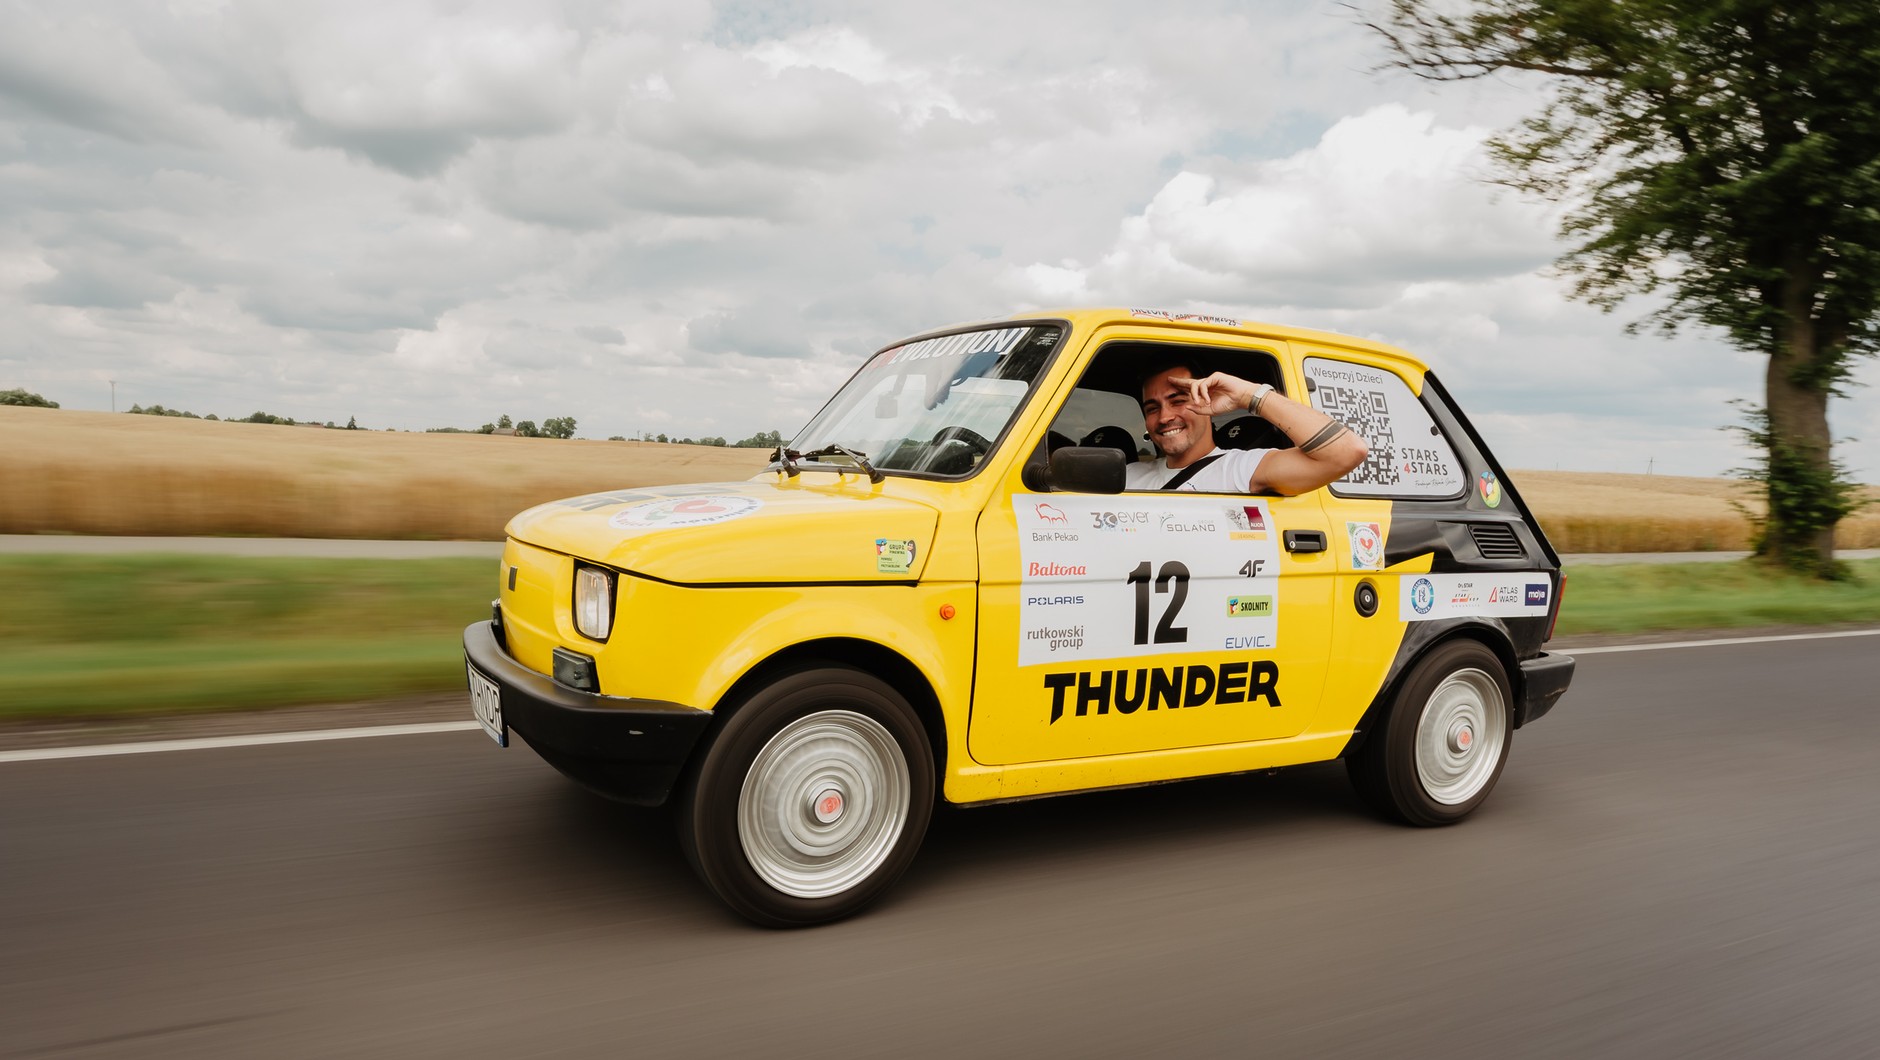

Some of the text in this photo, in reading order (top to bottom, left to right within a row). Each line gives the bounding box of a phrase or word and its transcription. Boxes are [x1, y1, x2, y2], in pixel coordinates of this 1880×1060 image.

[1310, 366, 1383, 384] Wesprzyj Dzieci
[1401, 447, 1439, 462] STARS
[1404, 461, 1448, 476] 4STARS
[1167, 523, 1216, 532] SOLANO
[1032, 532, 1079, 541] Bank Pekao
[1028, 561, 1087, 577] Baltona
[1239, 560, 1265, 578] 4F
[1028, 596, 1084, 606] POLARIS
[1127, 560, 1190, 645] 12
[1241, 602, 1268, 611] SKOLNITY
[1027, 625, 1084, 640] rutkowski
[1050, 638, 1084, 651] group
[1044, 660, 1282, 726] THUNDER
